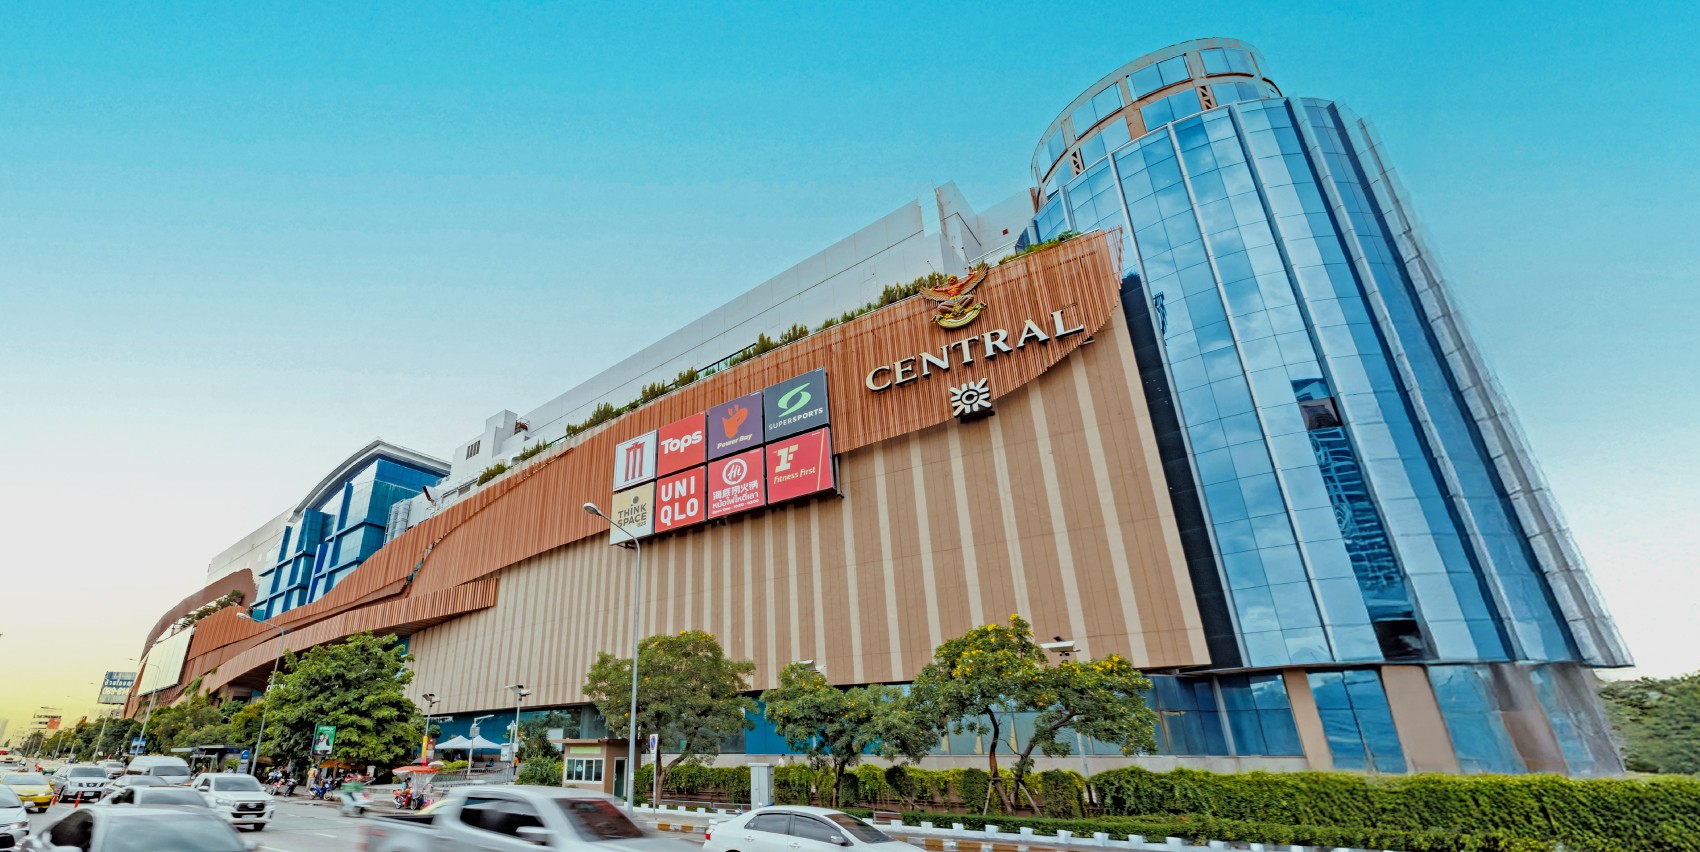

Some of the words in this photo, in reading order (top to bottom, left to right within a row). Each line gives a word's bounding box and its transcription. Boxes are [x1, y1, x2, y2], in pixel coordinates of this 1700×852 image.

[865, 310, 1085, 392] CENTRAL
[769, 407, 824, 430] SUPERSPORTS
[661, 430, 703, 455] Tops
[717, 438, 738, 449] Power
[739, 433, 753, 442] Buy
[661, 475, 695, 502] UNI
[617, 511, 647, 527] SPACE
[660, 497, 699, 526] QLO
